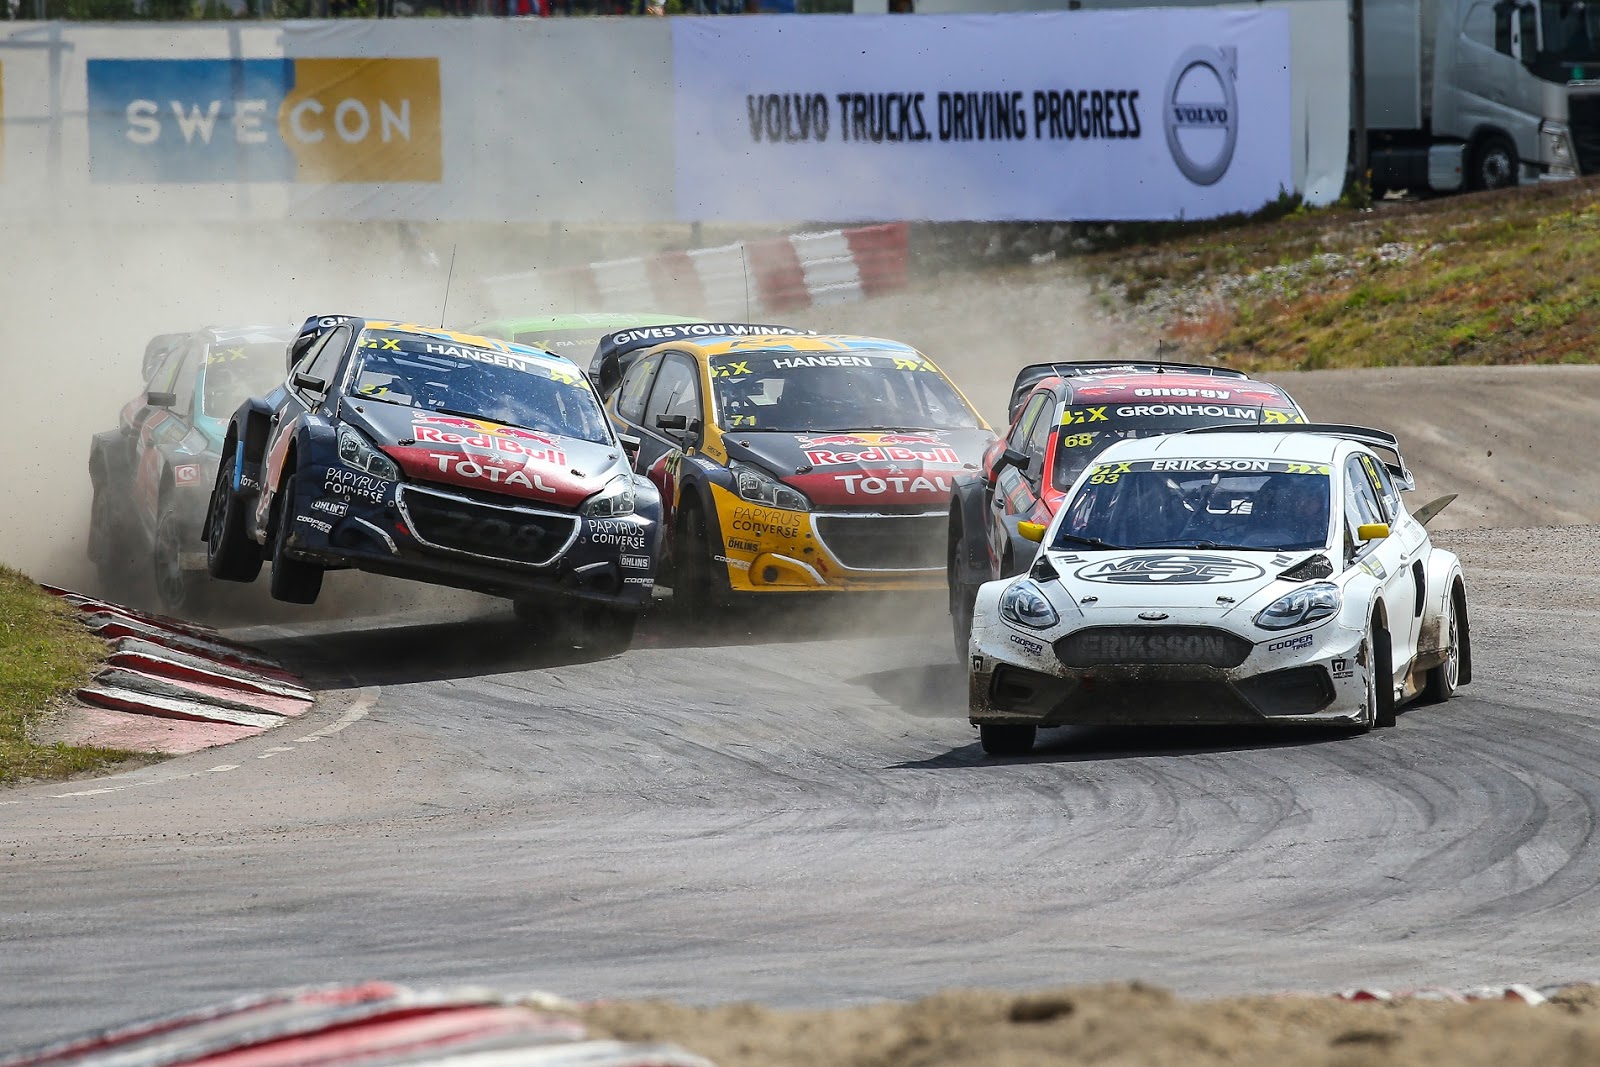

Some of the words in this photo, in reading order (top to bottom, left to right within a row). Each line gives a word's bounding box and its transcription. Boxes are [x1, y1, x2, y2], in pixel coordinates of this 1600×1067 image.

[126, 98, 411, 144] SWECON
[746, 93, 830, 143] VOLVO
[836, 92, 932, 142] TRUCKS.
[937, 91, 1026, 140] DRIVING
[1033, 89, 1142, 139] PROGRESS
[1174, 107, 1228, 123] VOLVO
[612, 326, 675, 346] GIVES
[676, 323, 727, 336] YOU
[426, 343, 527, 372] HANSEN
[772, 355, 872, 369] HANSEN
[360, 384, 388, 396] 21
[1134, 388, 1230, 399] energy
[731, 415, 756, 426] 71
[1116, 404, 1257, 420] GRONHOLM
[412, 425, 491, 449] Red
[496, 438, 567, 467] Bull
[1064, 434, 1093, 447] 68
[804, 447, 886, 466] Red
[884, 446, 961, 464] Bull
[429, 453, 556, 494] TOTAL
[1151, 460, 1270, 471] ERIKSSON
[325, 466, 390, 493] PAPYRUS
[1090, 473, 1120, 485] 93
[296, 514, 333, 530] COOPER
[734, 506, 802, 527] PAPYRUS
[588, 520, 645, 537] PAPYRUS
[732, 519, 799, 539] CONVERSE
[592, 533, 645, 550] CONVERSE
[1096, 558, 1238, 578] MSE
[1010, 634, 1042, 652] COOPER
[1268, 634, 1313, 652] COOPER
[1292, 641, 1313, 651] TIRES
